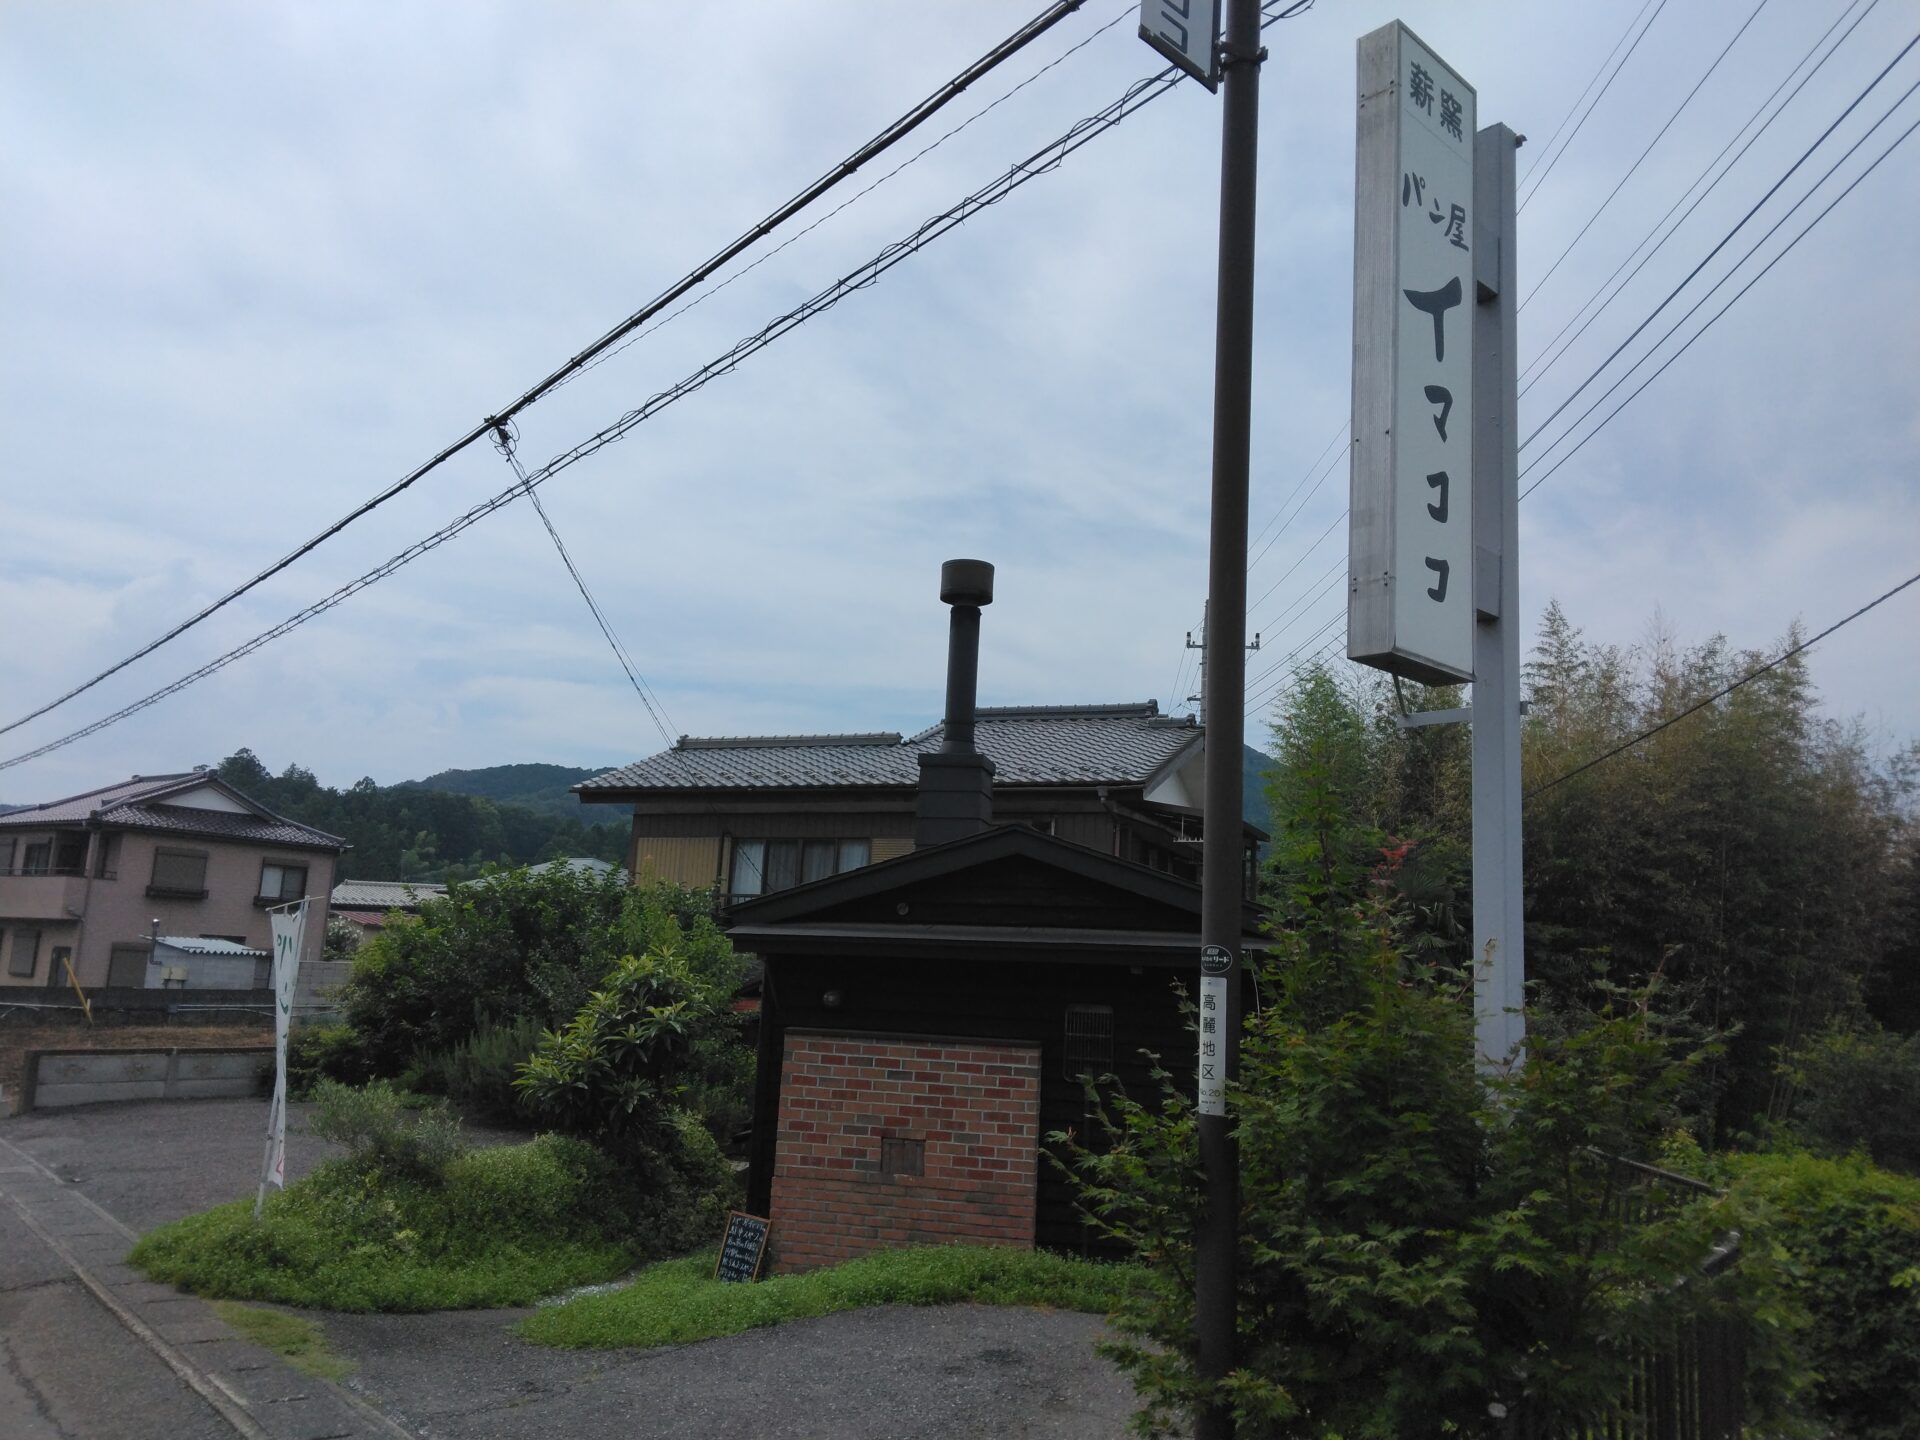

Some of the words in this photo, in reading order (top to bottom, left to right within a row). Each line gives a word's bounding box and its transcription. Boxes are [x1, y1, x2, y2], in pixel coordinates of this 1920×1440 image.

[1402, 171, 1470, 252] パン屋
[1201, 993, 1217, 1081] 高麗地区
